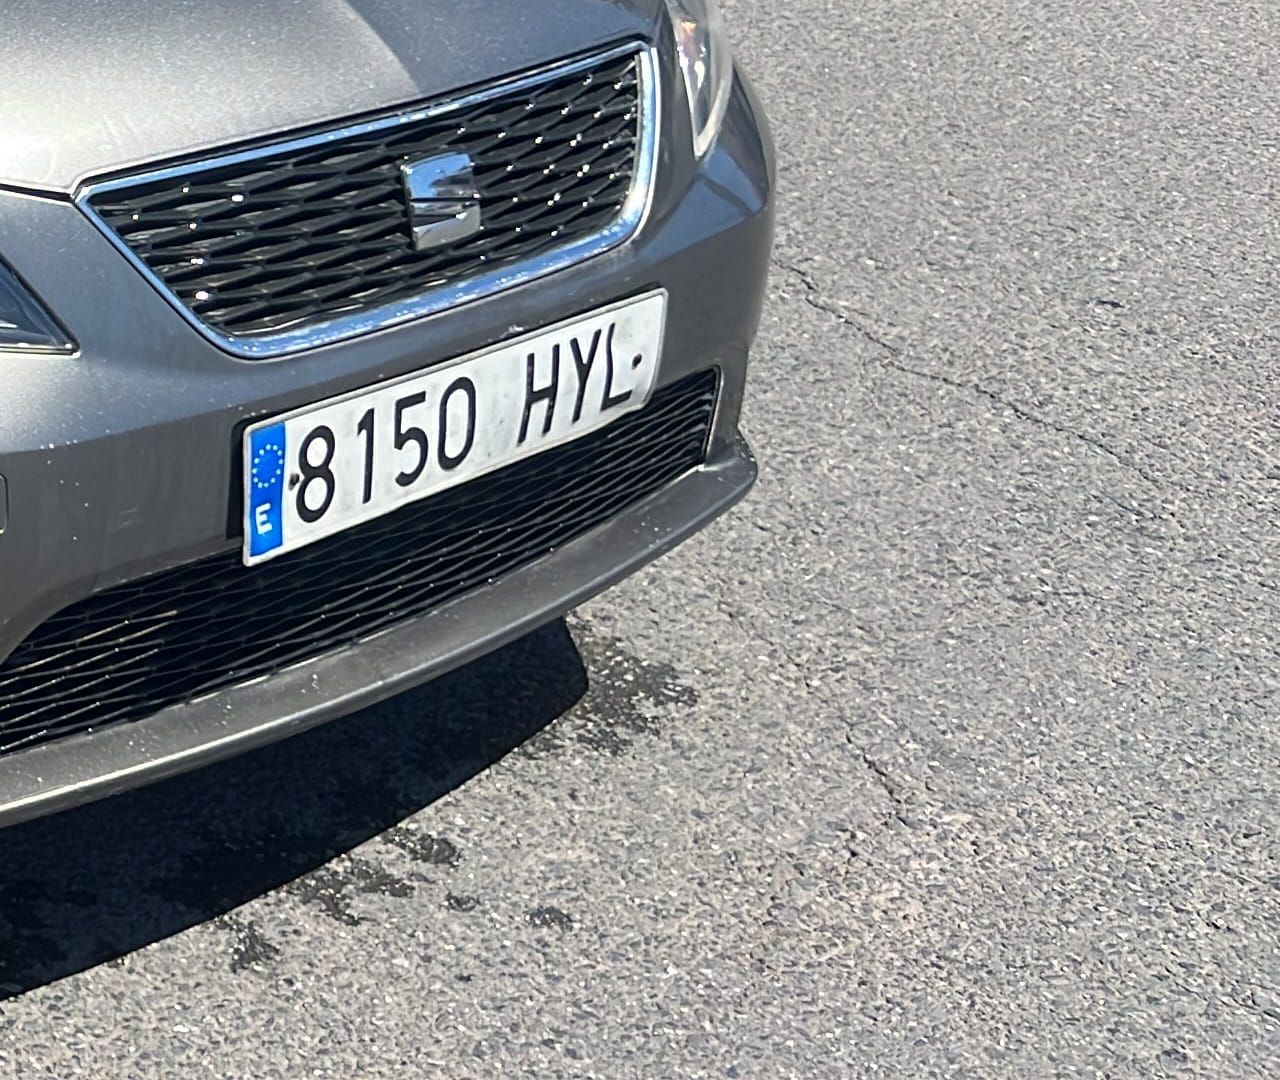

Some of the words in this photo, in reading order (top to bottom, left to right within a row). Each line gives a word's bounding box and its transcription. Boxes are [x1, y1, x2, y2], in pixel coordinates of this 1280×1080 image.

[294, 376, 477, 524] 8150
[516, 322, 633, 448] HYL
[255, 502, 272, 536] E
